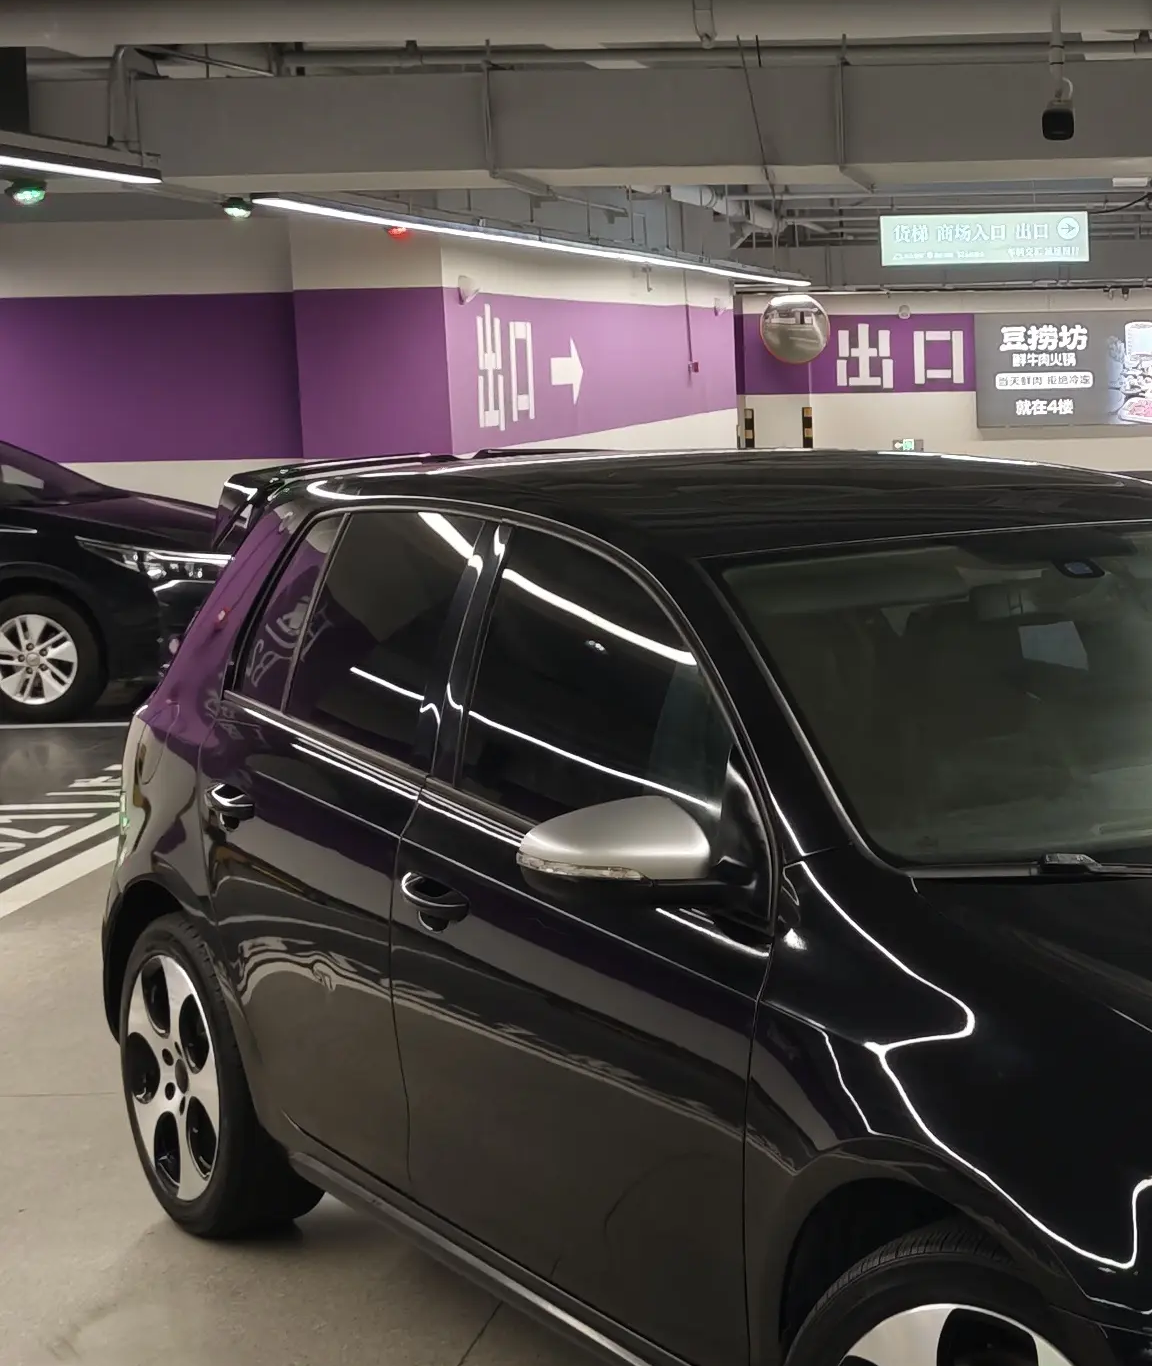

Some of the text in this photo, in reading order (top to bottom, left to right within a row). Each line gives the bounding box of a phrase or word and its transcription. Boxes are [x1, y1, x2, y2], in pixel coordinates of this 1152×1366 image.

[893, 221, 1049, 243] 货梯 商场入口 出口
[1000, 324, 1088, 351] 豆捞坊
[476, 303, 535, 431] 出口
[836, 322, 965, 389] 出口
[1012, 352, 1077, 367] 鲜牛肉火锅
[1015, 398, 1074, 415] 就在4楼
